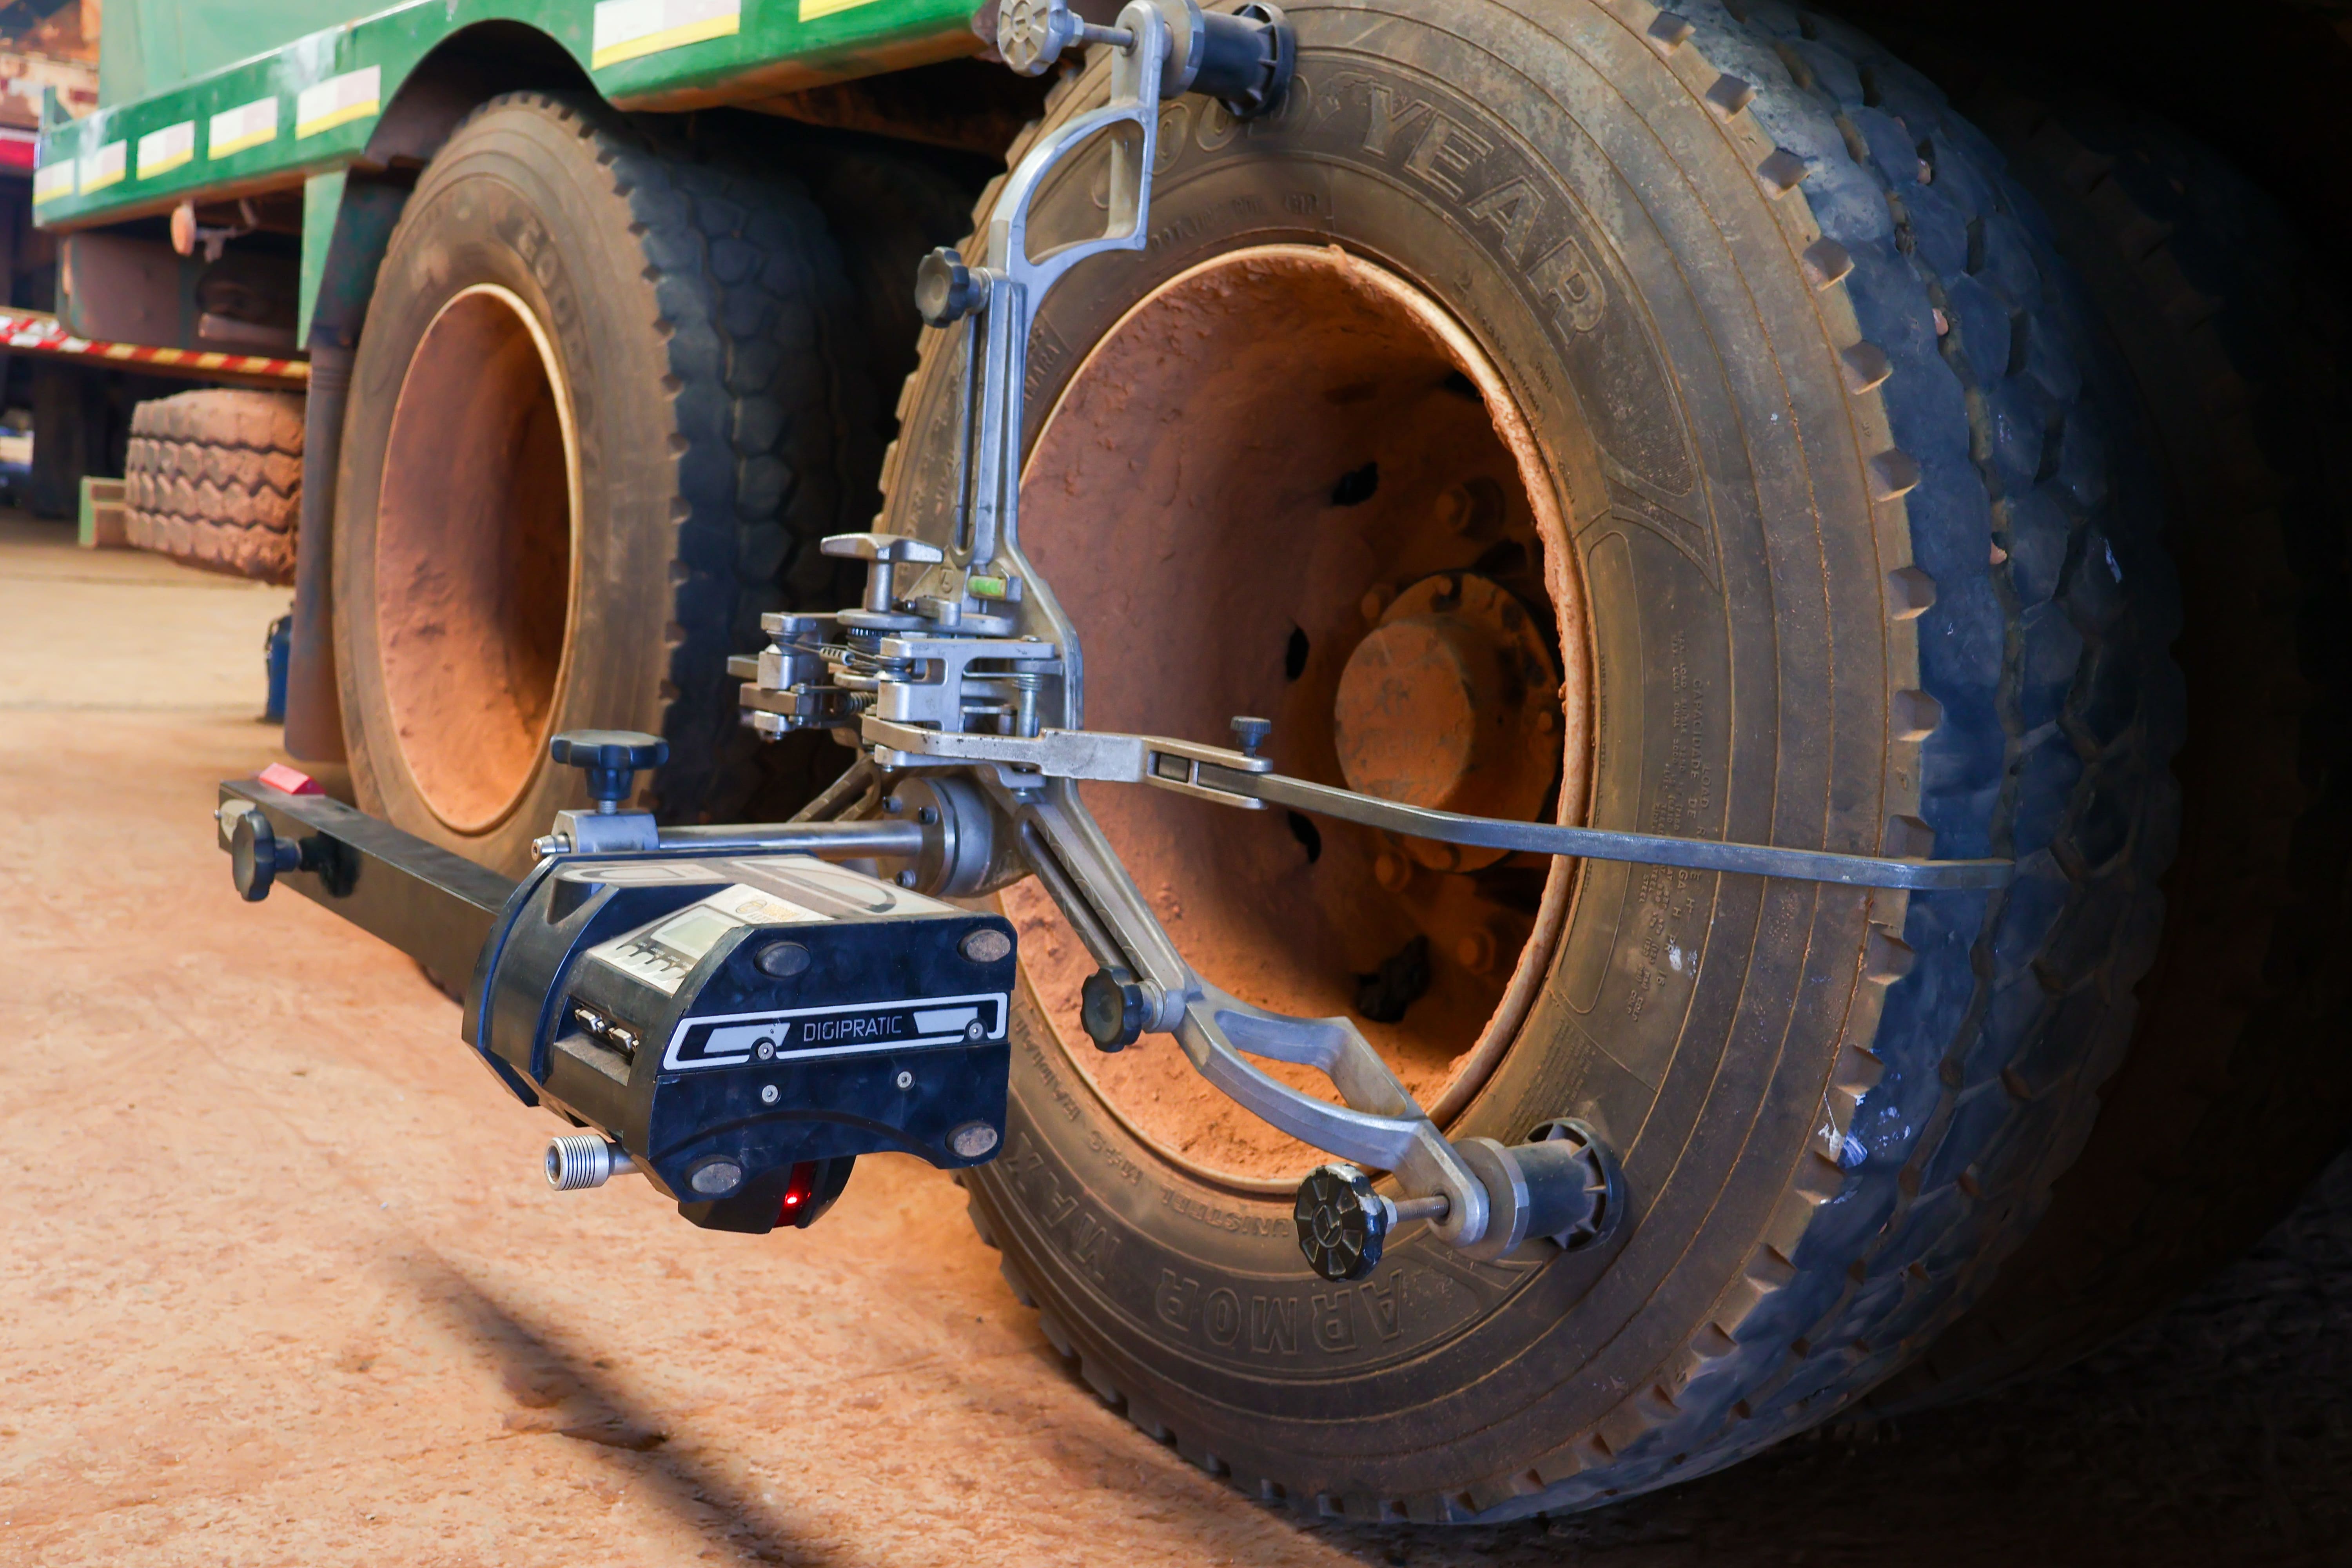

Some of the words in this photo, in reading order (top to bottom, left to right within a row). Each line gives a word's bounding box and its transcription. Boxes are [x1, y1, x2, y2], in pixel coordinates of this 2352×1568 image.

[1362, 83, 1607, 345] YEAR
[1690, 679, 1704, 779] CAPACIDADE
[1687, 797, 1697, 819] DE
[1699, 765, 1711, 808] LOAD
[804, 1016, 902, 1042] DIGIPRATIC
[1007, 1132, 1120, 1278] MAX
[1159, 1185, 1290, 1238] UNISTEEL
[1159, 1267, 1403, 1353] ARMOR
